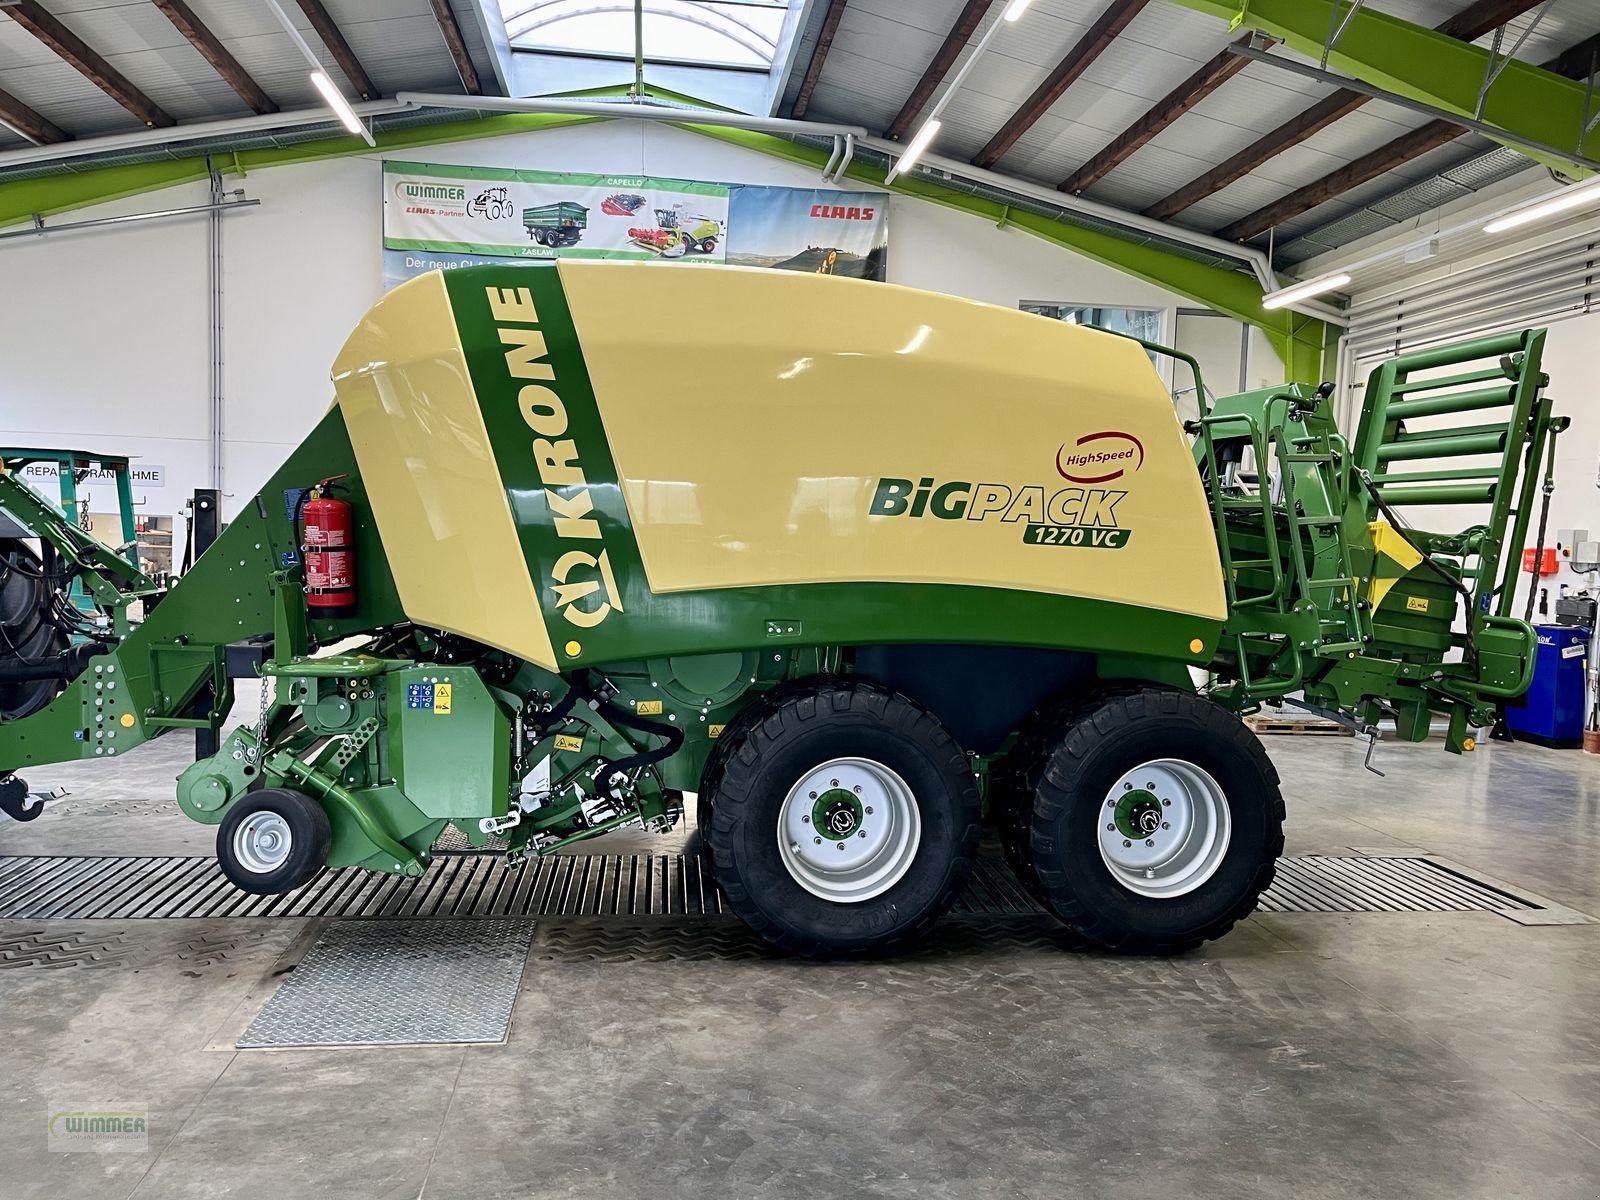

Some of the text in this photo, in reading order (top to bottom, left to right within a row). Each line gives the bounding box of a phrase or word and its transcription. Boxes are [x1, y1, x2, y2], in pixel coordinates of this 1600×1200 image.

[607, 178, 643, 187] CAPELLO
[406, 185, 465, 201] WIMMER
[809, 205, 874, 221] CLAAS
[521, 248, 554, 257] ZASLAW
[405, 257, 427, 268] Der
[429, 261, 457, 270] neue
[485, 286, 603, 539] KRONE
[1066, 448, 1134, 467] HighSpeed
[1034, 527, 1120, 547] 1270 VC
